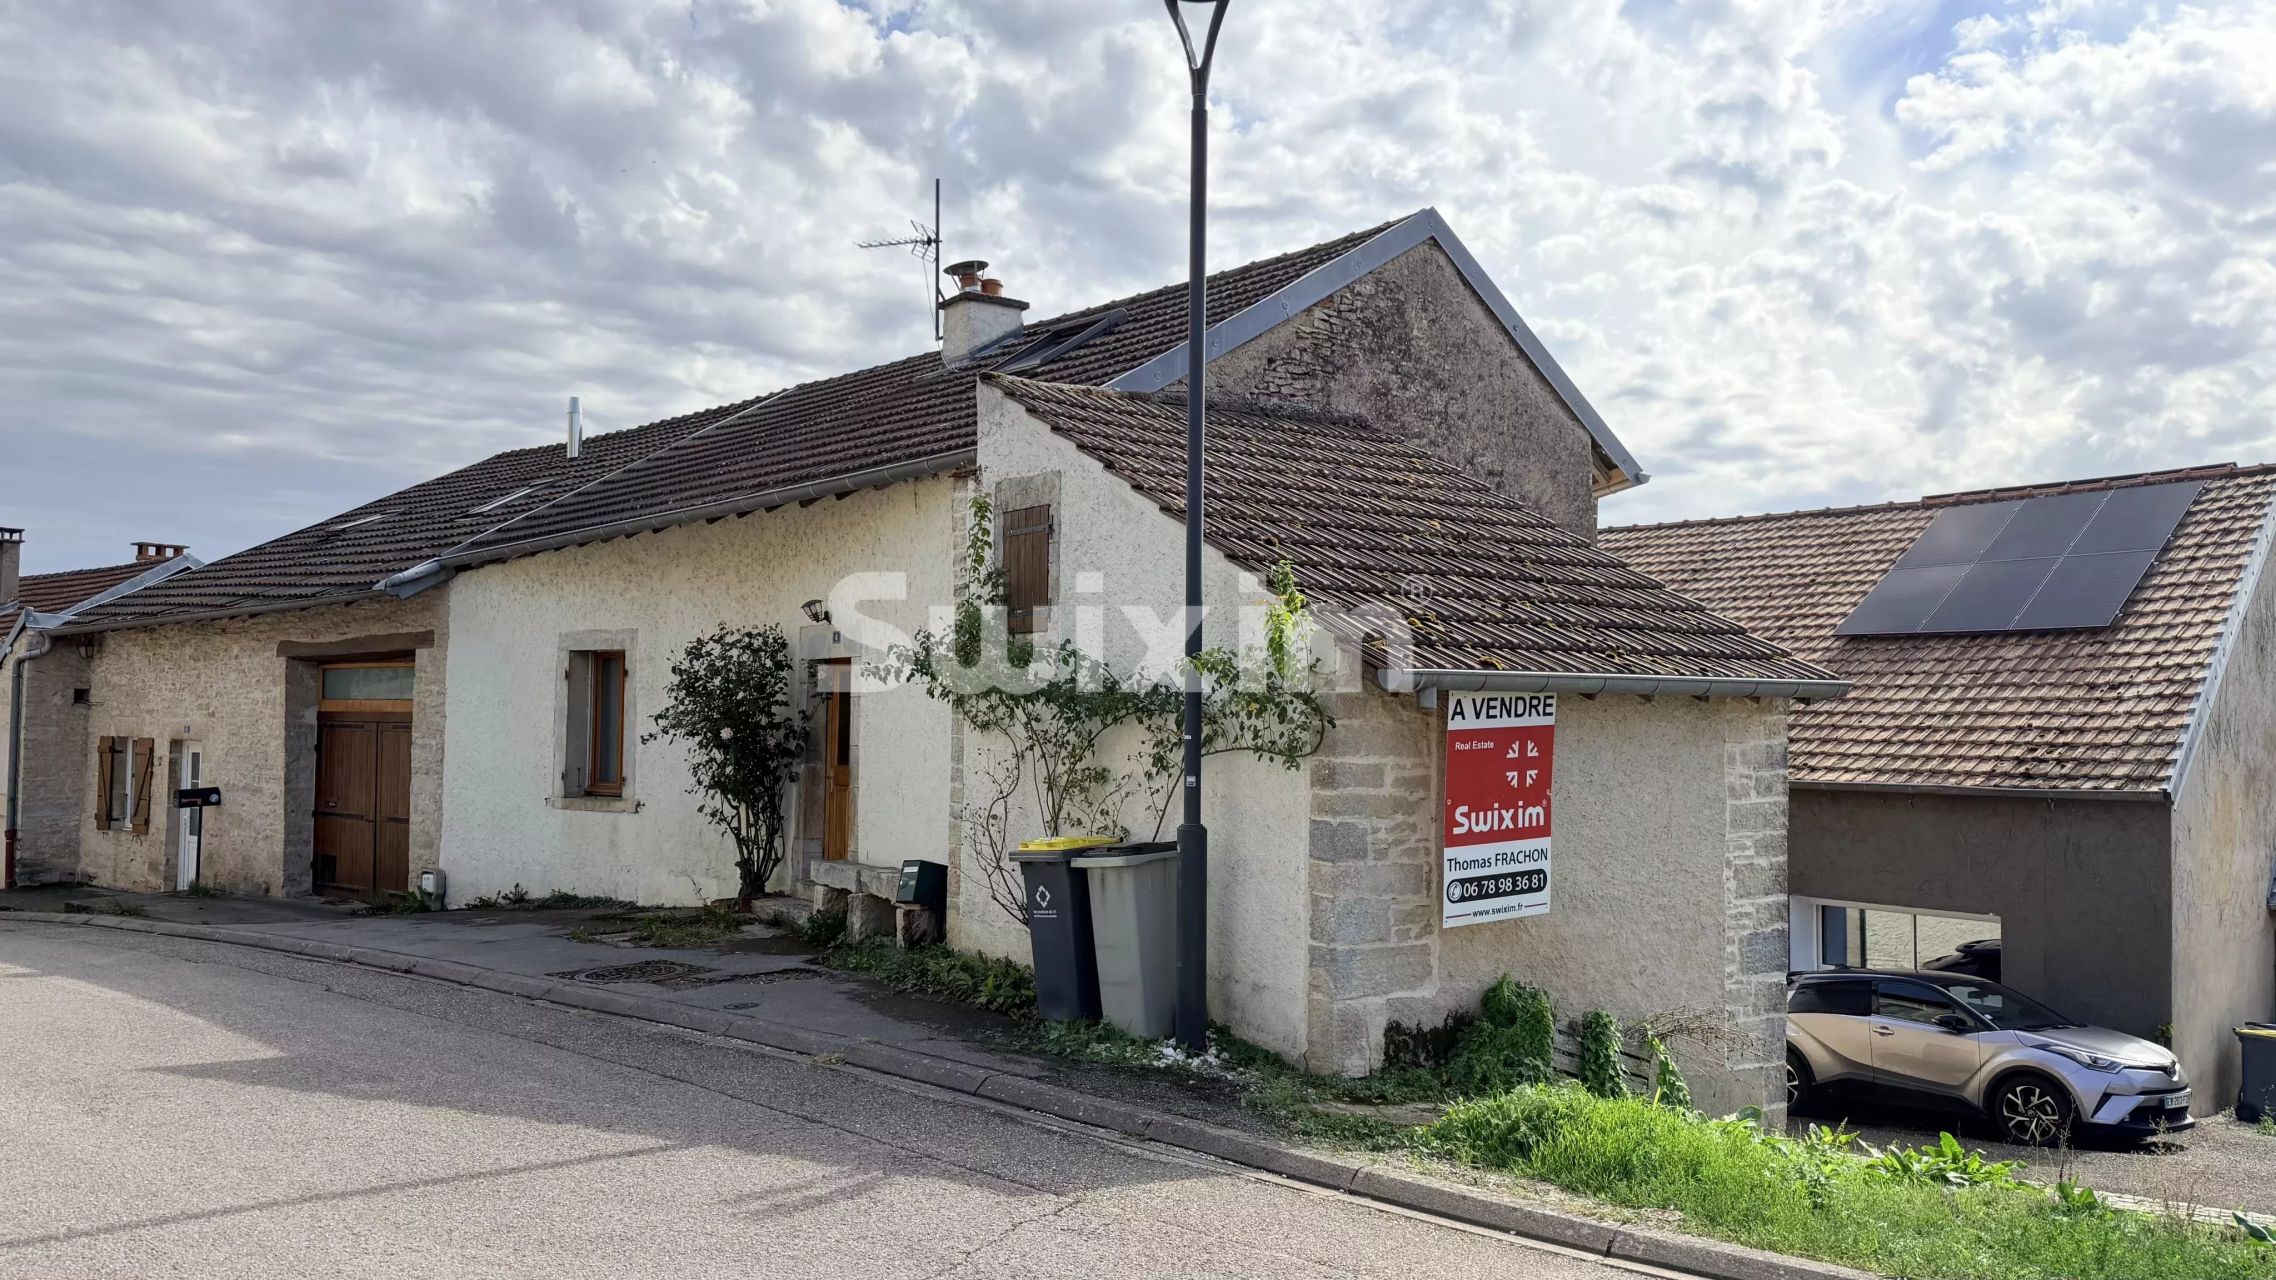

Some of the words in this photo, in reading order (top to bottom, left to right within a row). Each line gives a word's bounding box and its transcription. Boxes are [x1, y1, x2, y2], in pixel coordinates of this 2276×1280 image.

[1450, 698, 1466, 720] A
[1472, 695, 1555, 719] VENDRE
[1455, 742, 1471, 750] Real
[1472, 740, 1495, 750] Estate
[1453, 800, 1545, 834] Swixim
[1447, 857, 1492, 872] Thomas
[1494, 847, 1548, 867] FRACHON
[1463, 882, 1478, 897] 06
[1481, 880, 1496, 895] 78
[1498, 877, 1513, 892] 98
[1515, 875, 1529, 891] 36
[1531, 873, 1544, 888] 81
[1472, 902, 1524, 918] www.swixim.fr
